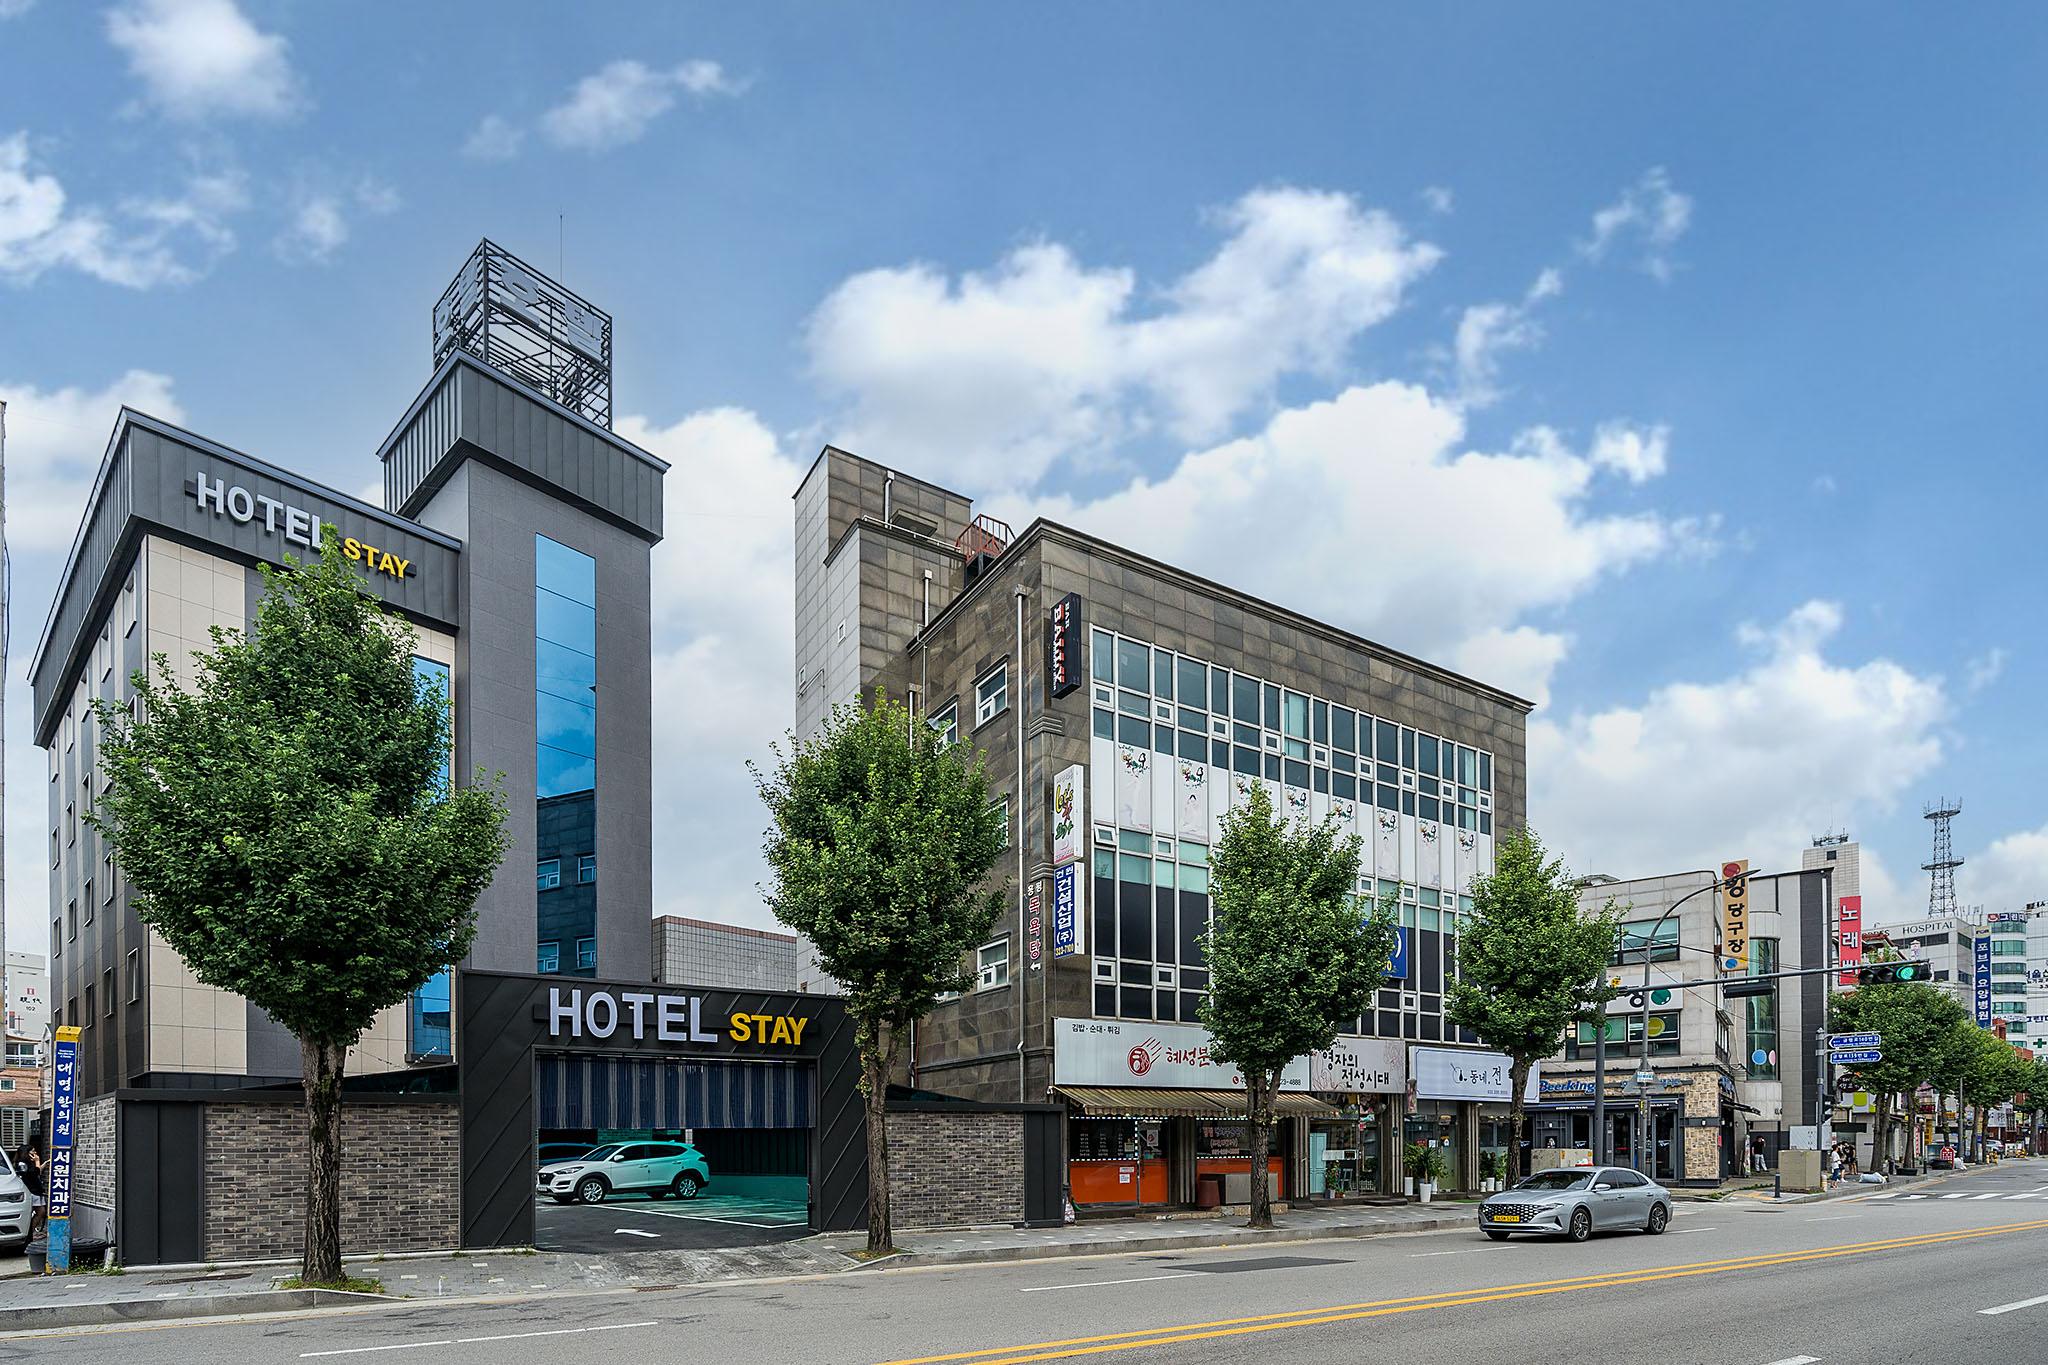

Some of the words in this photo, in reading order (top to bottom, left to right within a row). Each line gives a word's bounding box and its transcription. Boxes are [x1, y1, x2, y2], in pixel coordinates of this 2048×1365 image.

[197, 471, 322, 549] HOTEL
[343, 537, 411, 579] STAY
[1029, 896, 1042, 960] 목욕탕
[1902, 921, 1956, 935] HOSPITAL
[549, 987, 718, 1043] HOTEL
[729, 1012, 808, 1046] STAY
[1165, 1046, 1211, 1067] 혜성분
[1322, 1049, 1358, 1071] 영자의
[1341, 1067, 1390, 1090] 전성시대
[52, 1151, 70, 1204] 서원치과
[50, 1204, 70, 1214] 2F
